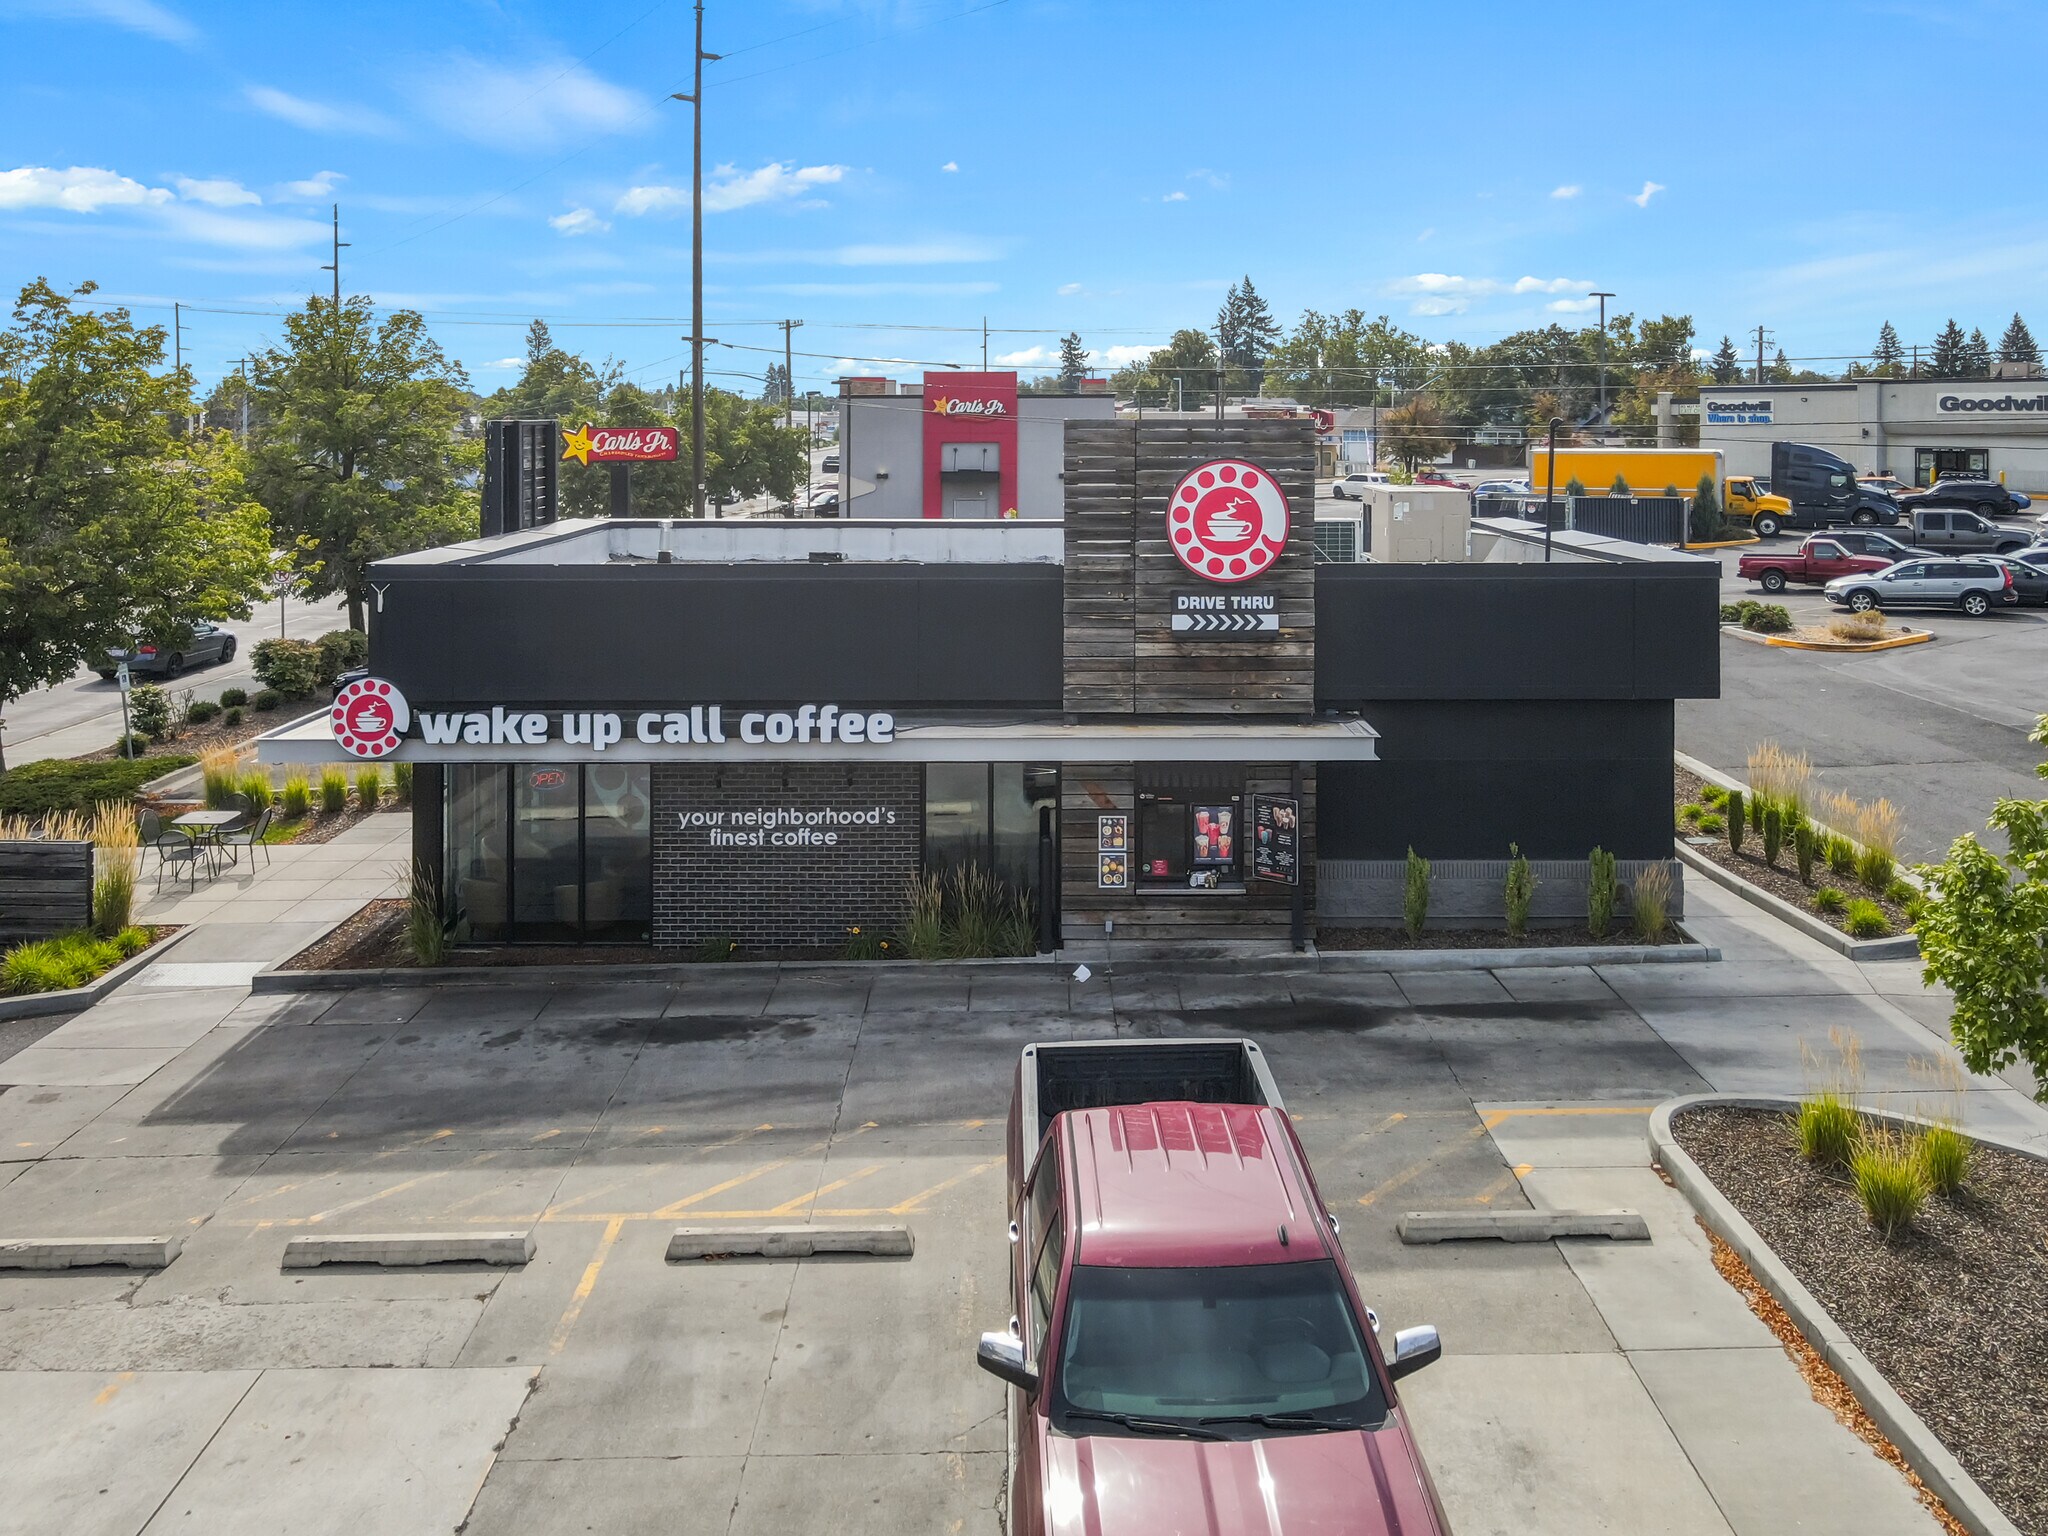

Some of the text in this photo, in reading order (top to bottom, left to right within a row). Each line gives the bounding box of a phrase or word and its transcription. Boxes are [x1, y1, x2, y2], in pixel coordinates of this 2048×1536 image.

[946, 398, 1007, 415] Carl's Jr.
[1707, 401, 1772, 412] Goodwill
[1707, 413, 1735, 424] Where
[1737, 413, 1746, 423] to
[592, 431, 673, 453] Carl's Jr.
[1177, 596, 1275, 610] DRIVE THRU
[418, 703, 895, 751] wake up call coffee
[529, 771, 566, 788] OPEN
[678, 806, 896, 830] your neighborhood's
[709, 828, 839, 846] finest coffee
